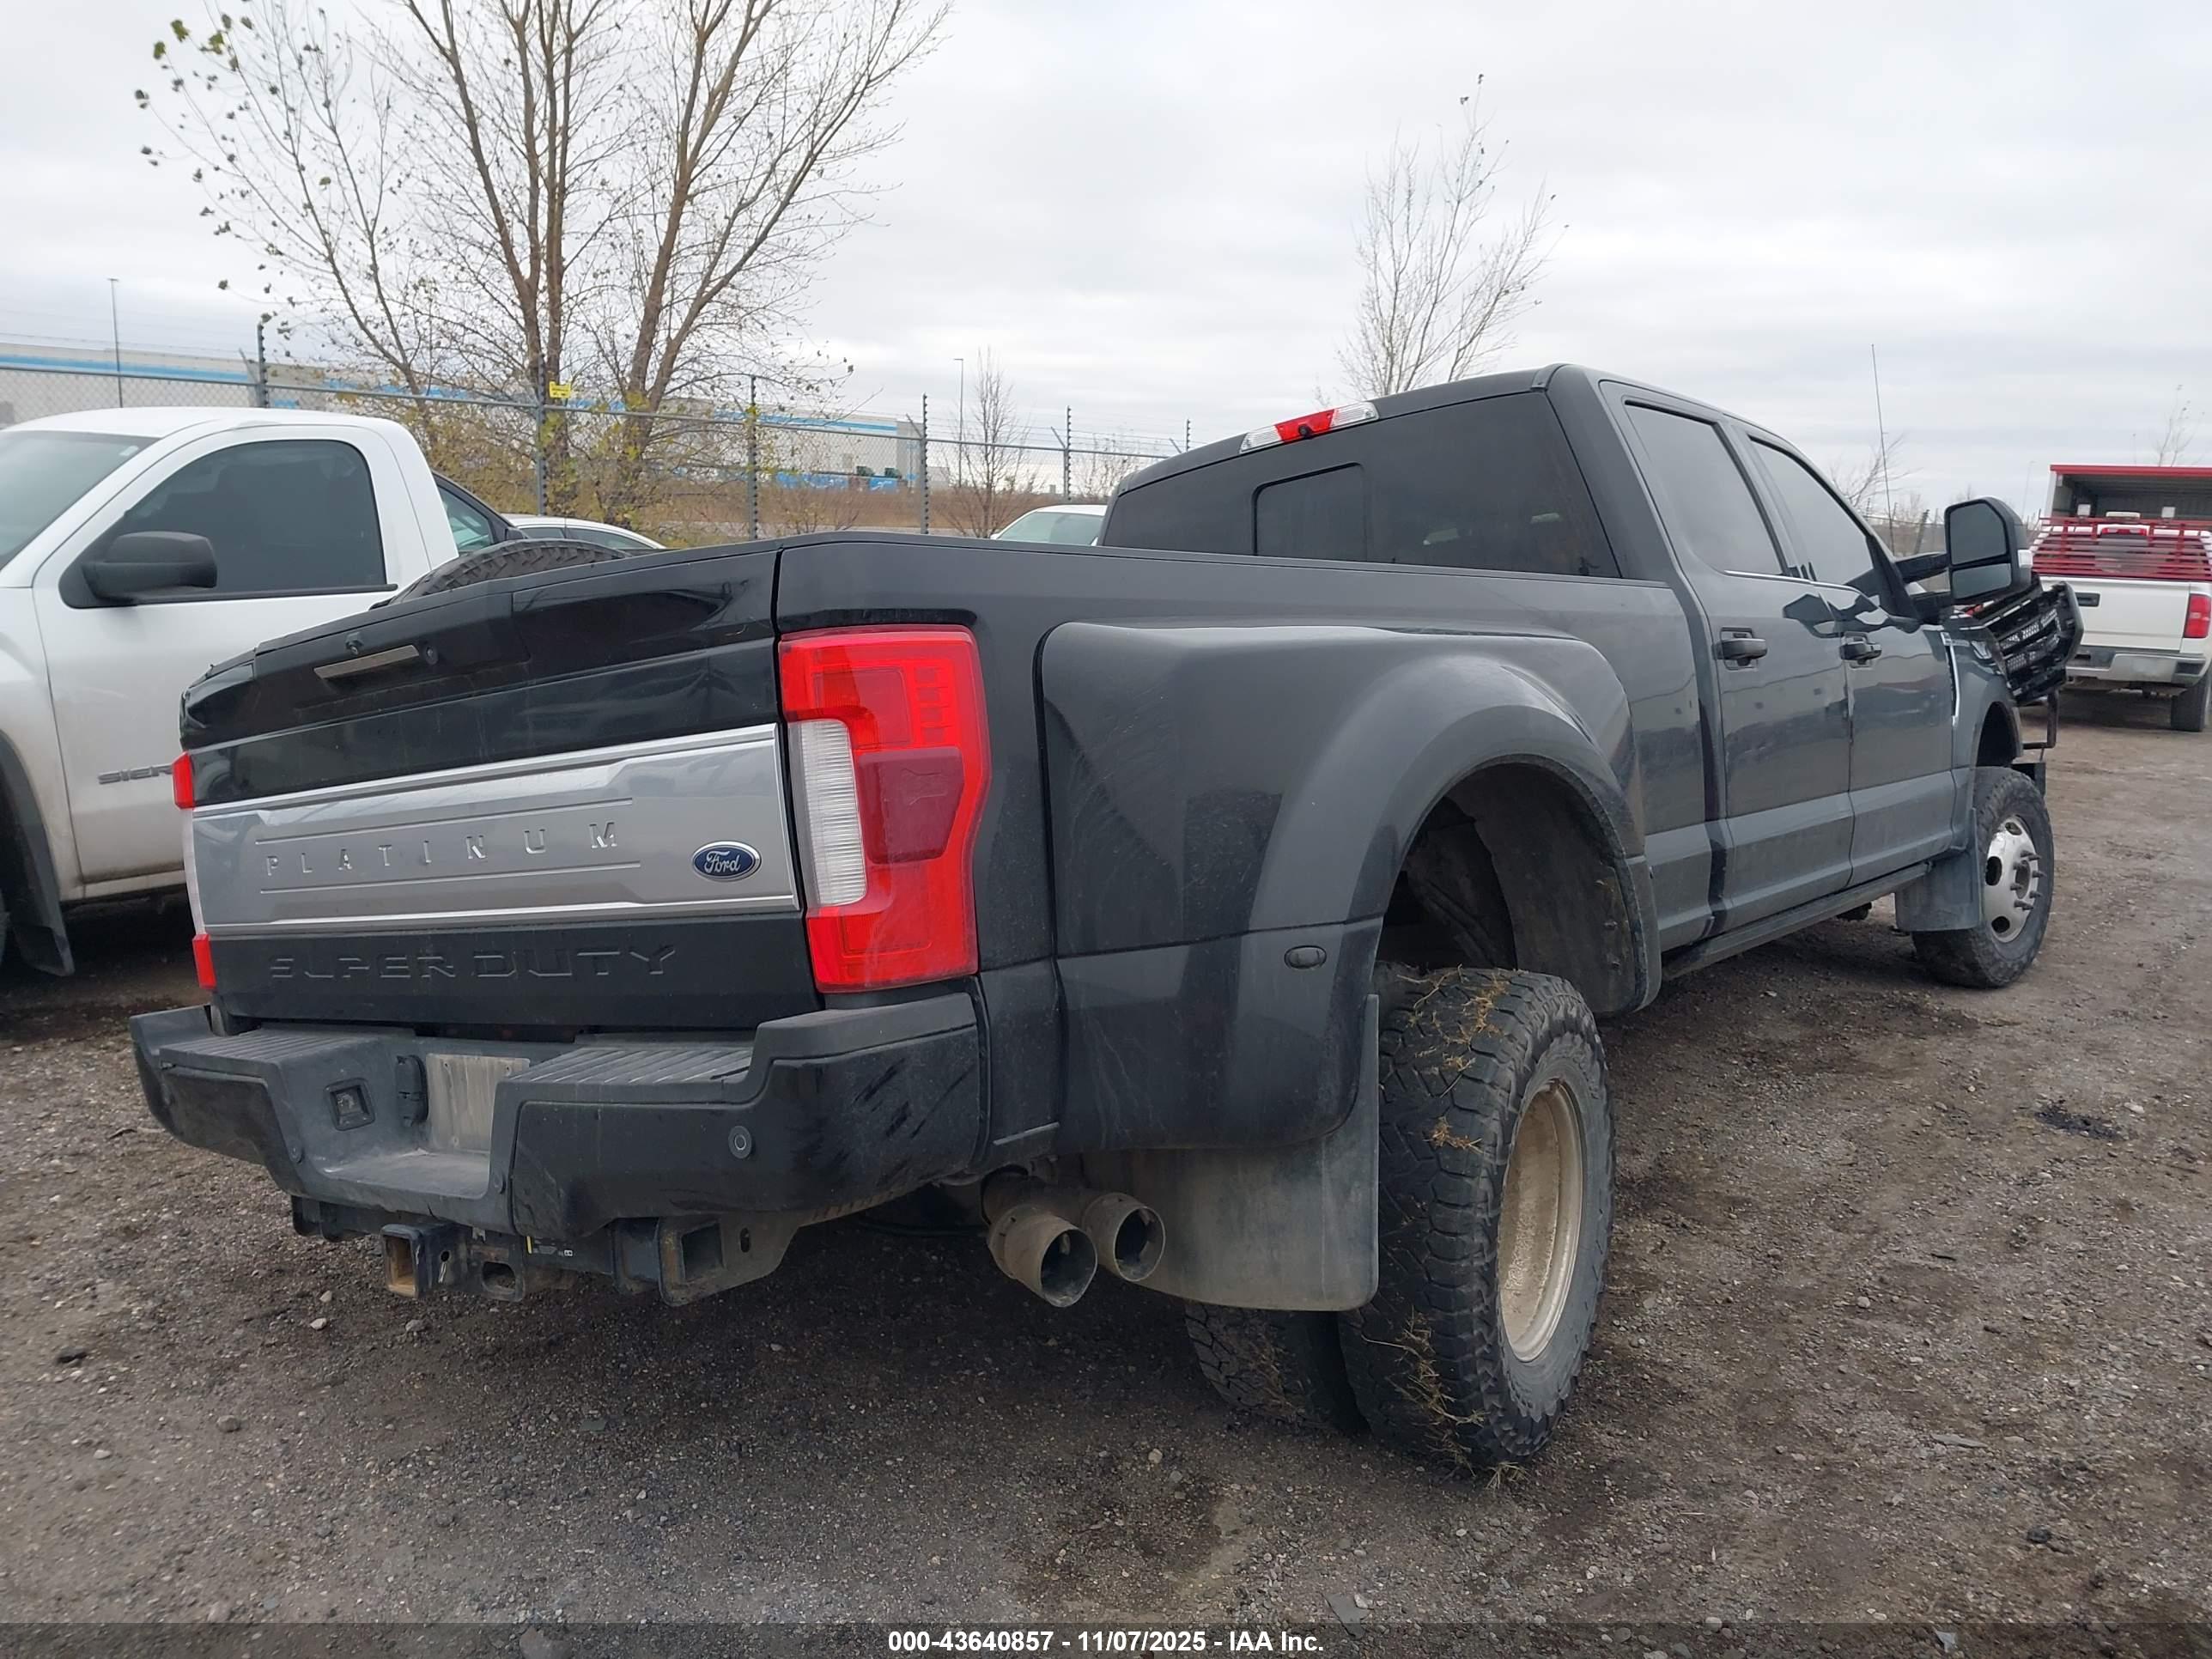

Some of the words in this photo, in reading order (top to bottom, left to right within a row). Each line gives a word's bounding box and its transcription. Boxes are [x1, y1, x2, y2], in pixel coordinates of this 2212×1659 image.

[266, 821, 618, 877] PLATINUM
[704, 850, 741, 873] Ford
[269, 955, 457, 979] SUPER
[471, 949, 677, 979] DUTY
